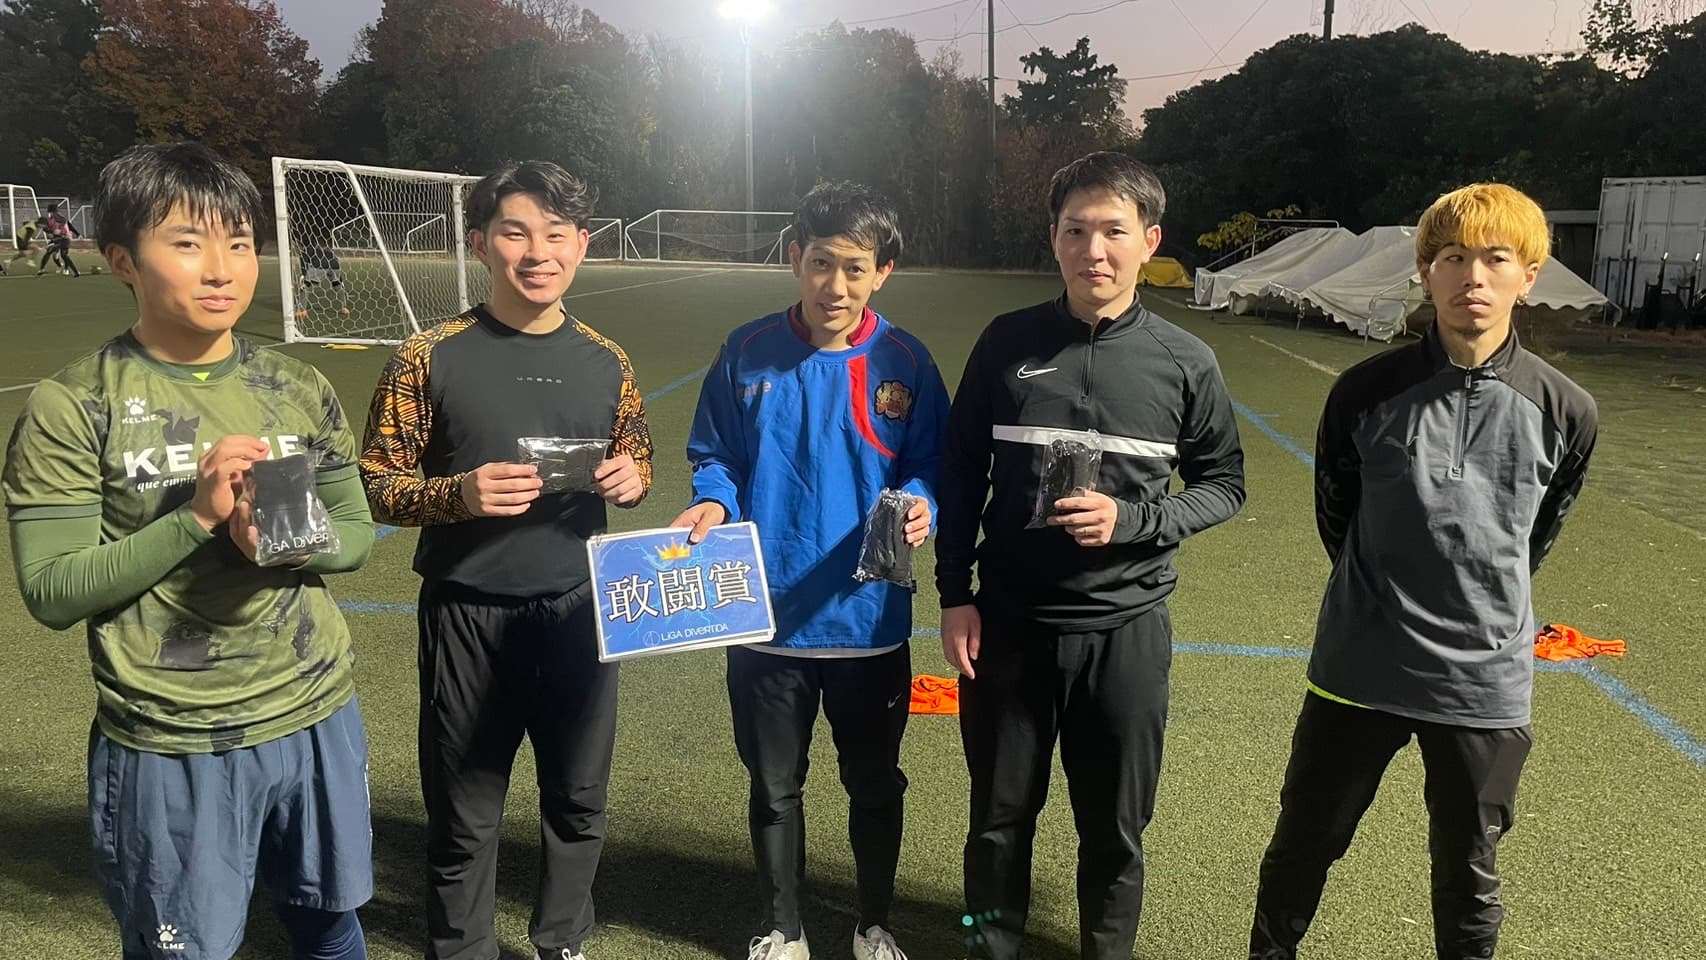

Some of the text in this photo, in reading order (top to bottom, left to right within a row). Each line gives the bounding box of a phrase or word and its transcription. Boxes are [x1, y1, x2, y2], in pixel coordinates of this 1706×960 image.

[121, 414, 161, 424] KELME
[123, 434, 304, 478] KEE
[137, 481, 160, 493] que
[605, 560, 758, 624] 敢闘賞
